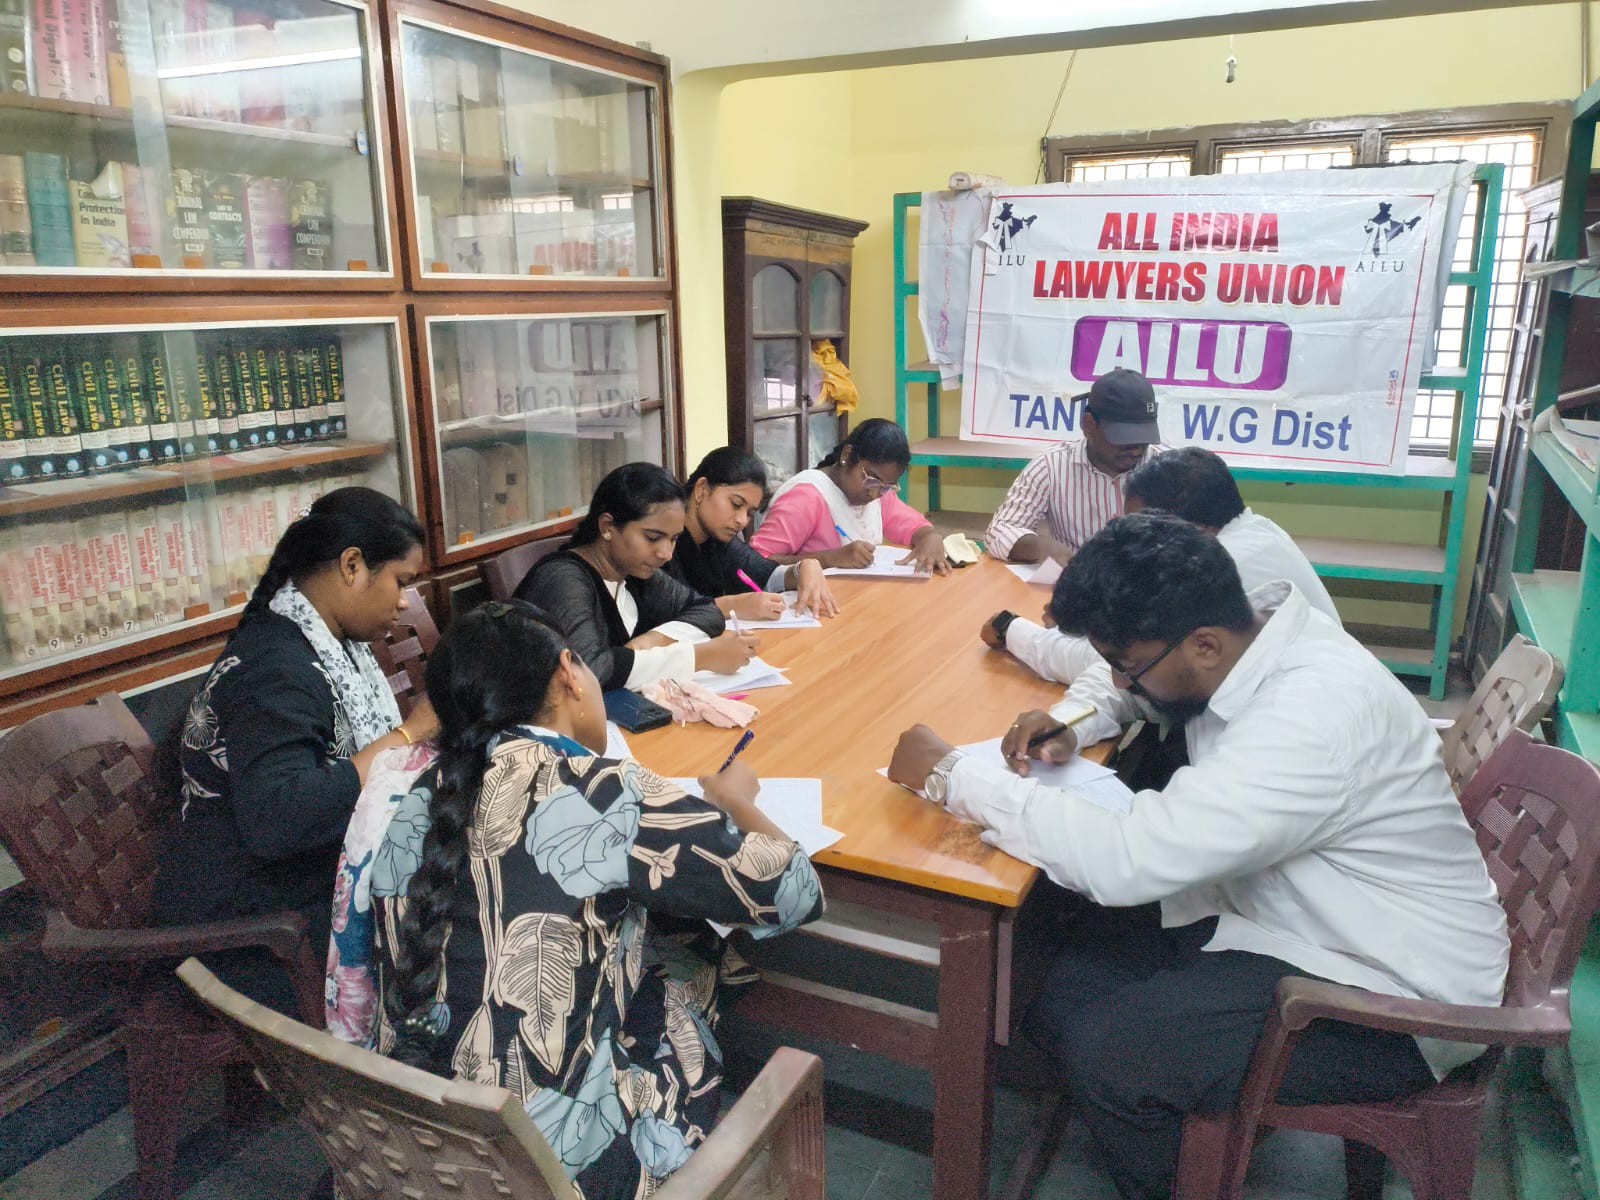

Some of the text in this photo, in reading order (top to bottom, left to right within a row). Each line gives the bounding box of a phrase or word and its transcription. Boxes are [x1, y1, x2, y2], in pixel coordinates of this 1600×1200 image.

[1097, 212, 1279, 252] ALL INDIA
[997, 254, 1026, 266] ILU
[1354, 260, 1405, 272] AILU
[1033, 260, 1346, 305] LAWYERS UNION
[240, 351, 250, 378] Civil
[257, 350, 268, 376] Civil
[279, 350, 288, 376] Civil
[311, 347, 321, 372] Civil
[1092, 320, 1269, 384] AILU
[26, 364, 41, 396] Civil
[52, 364, 67, 395] Civil
[105, 359, 117, 389] Civil
[127, 358, 139, 387] Civil
[152, 357, 165, 385] Civil
[198, 354, 211, 417] Civil Laws
[219, 355, 233, 417] Civil Laws
[328, 344, 341, 401] Civil Laws
[82, 361, 100, 430] Civil Laws
[244, 382, 254, 412] Laws
[261, 380, 271, 410] Laws
[282, 380, 291, 409] Laws
[301, 379, 309, 407] Laws
[315, 376, 324, 404] Laws
[1, 402, 15, 439] Laws
[32, 401, 46, 436] Laws
[58, 400, 71, 435] Laws
[109, 393, 121, 427] Laws
[131, 392, 143, 424] Laws
[157, 390, 168, 422] Laws
[1183, 403, 1258, 443] W.G
[1272, 408, 1352, 451] Dist
[101, 628, 108, 637] 3
[126, 621, 132, 631] 7
[155, 613, 164, 622] 10
[51, 640, 58, 649] 9
[76, 635, 83, 644] 5
